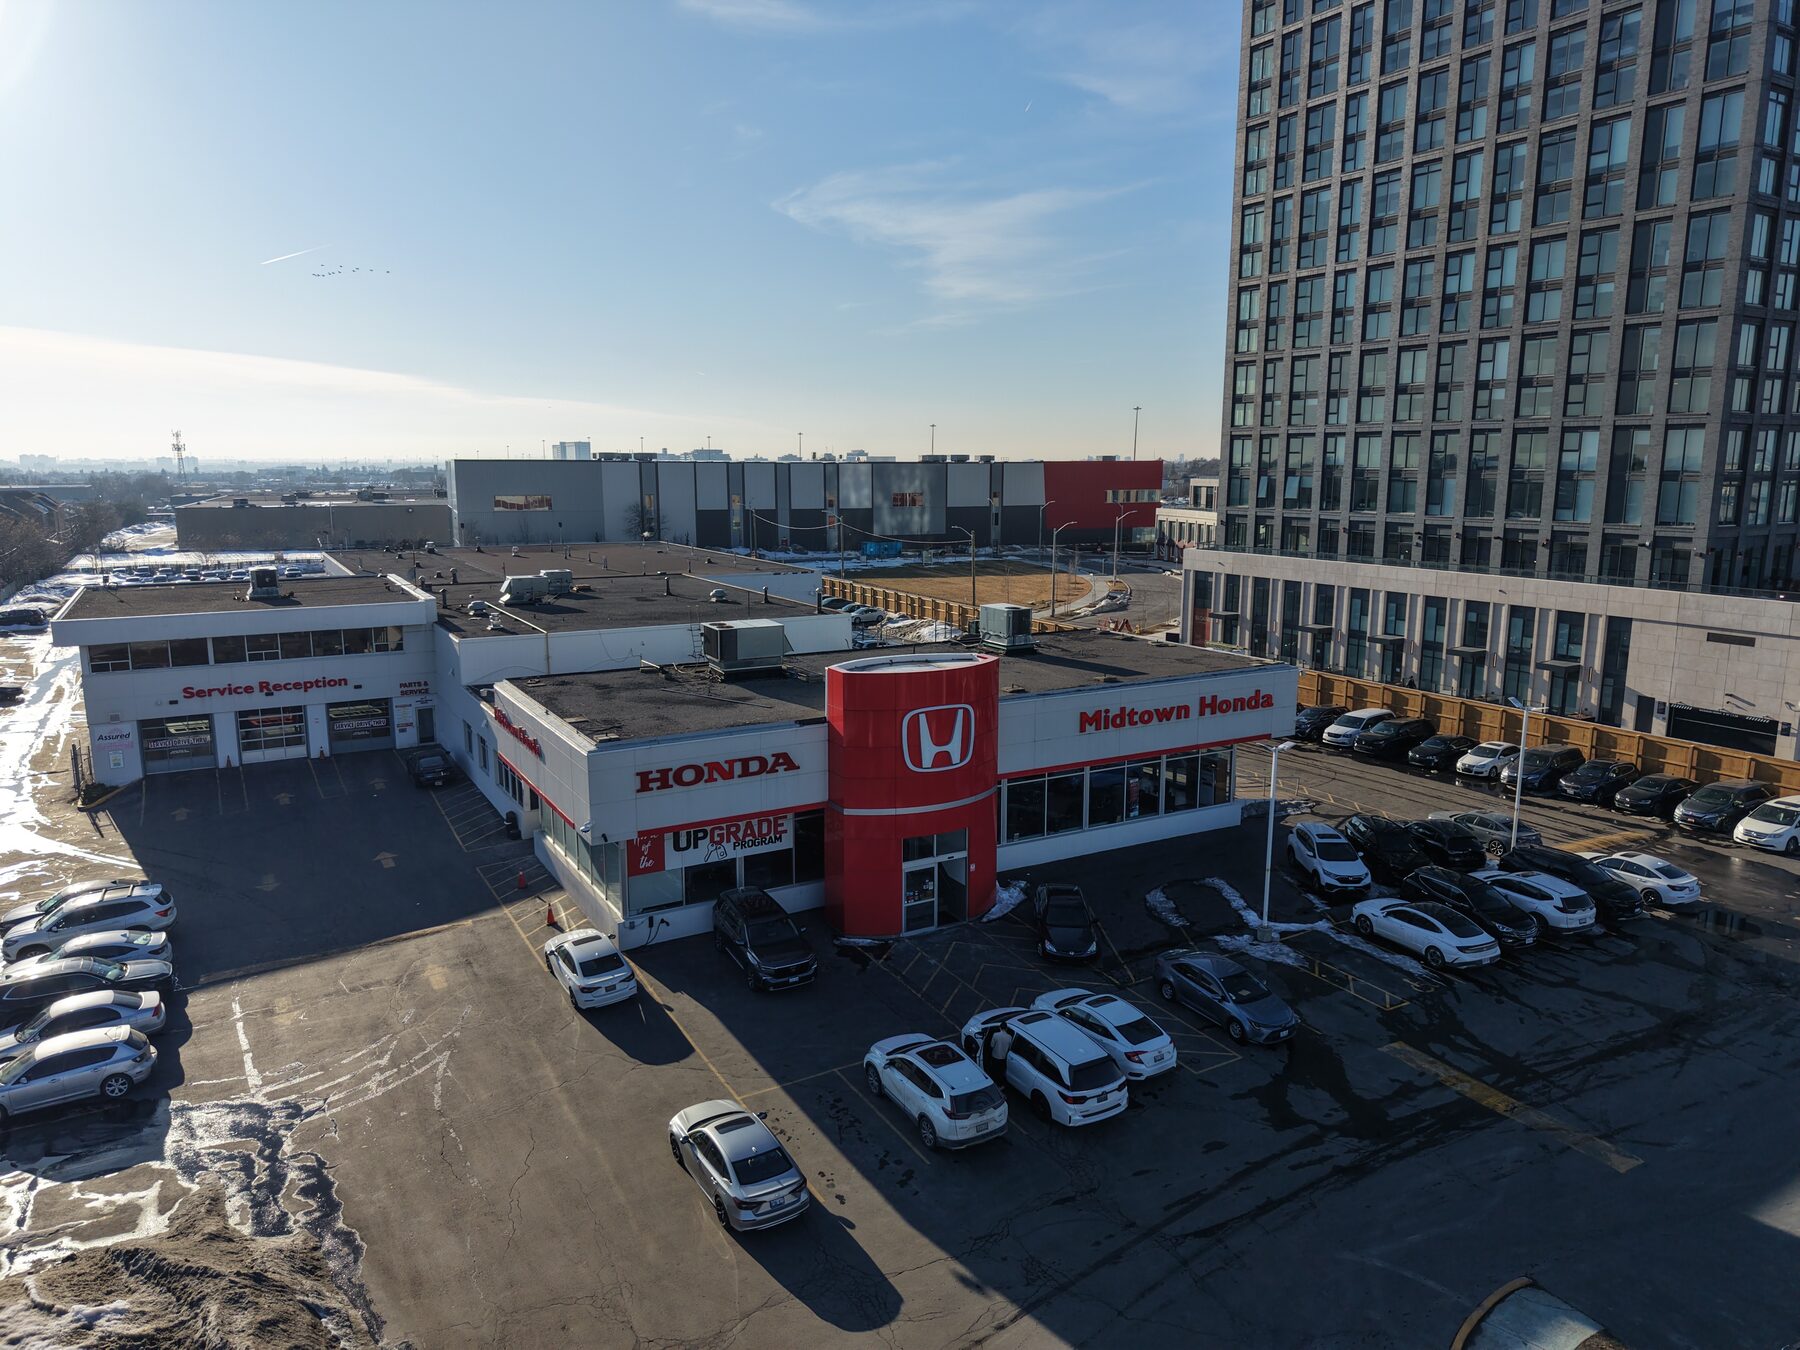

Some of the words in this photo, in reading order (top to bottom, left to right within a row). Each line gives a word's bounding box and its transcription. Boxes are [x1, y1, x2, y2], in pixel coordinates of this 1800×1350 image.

[182, 683, 255, 699] Service
[258, 676, 348, 693] Reception
[399, 681, 422, 689] PARTS
[400, 688, 430, 697] SERVICE
[1079, 706, 1190, 733] Midtown
[1198, 689, 1274, 717] Honda
[97, 732, 131, 742] Assured
[636, 752, 801, 793] HONDA
[672, 815, 788, 852] UPGRADE
[733, 835, 783, 851] PROGRAM
[639, 855, 655, 869] the
